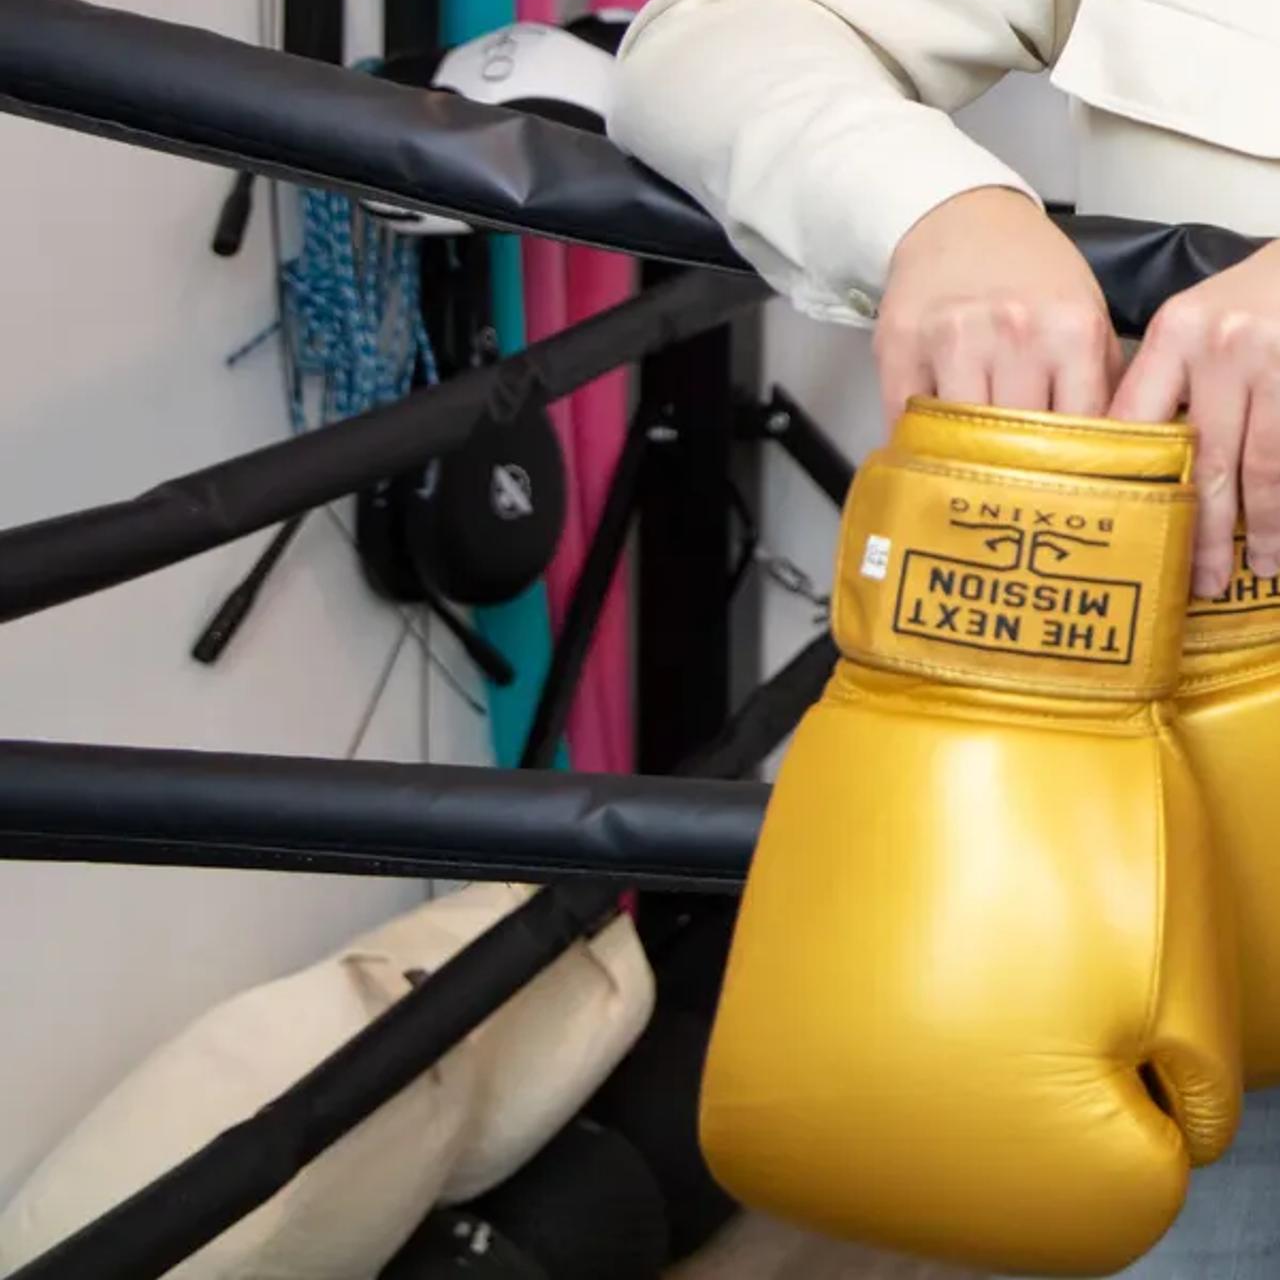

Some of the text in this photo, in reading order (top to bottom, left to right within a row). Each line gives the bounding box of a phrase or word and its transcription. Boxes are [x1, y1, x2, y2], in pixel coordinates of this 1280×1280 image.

[951, 496, 1115, 531] BOXING
[929, 567, 1110, 617] MISSION
[907, 598, 1120, 652] THE NEXT
